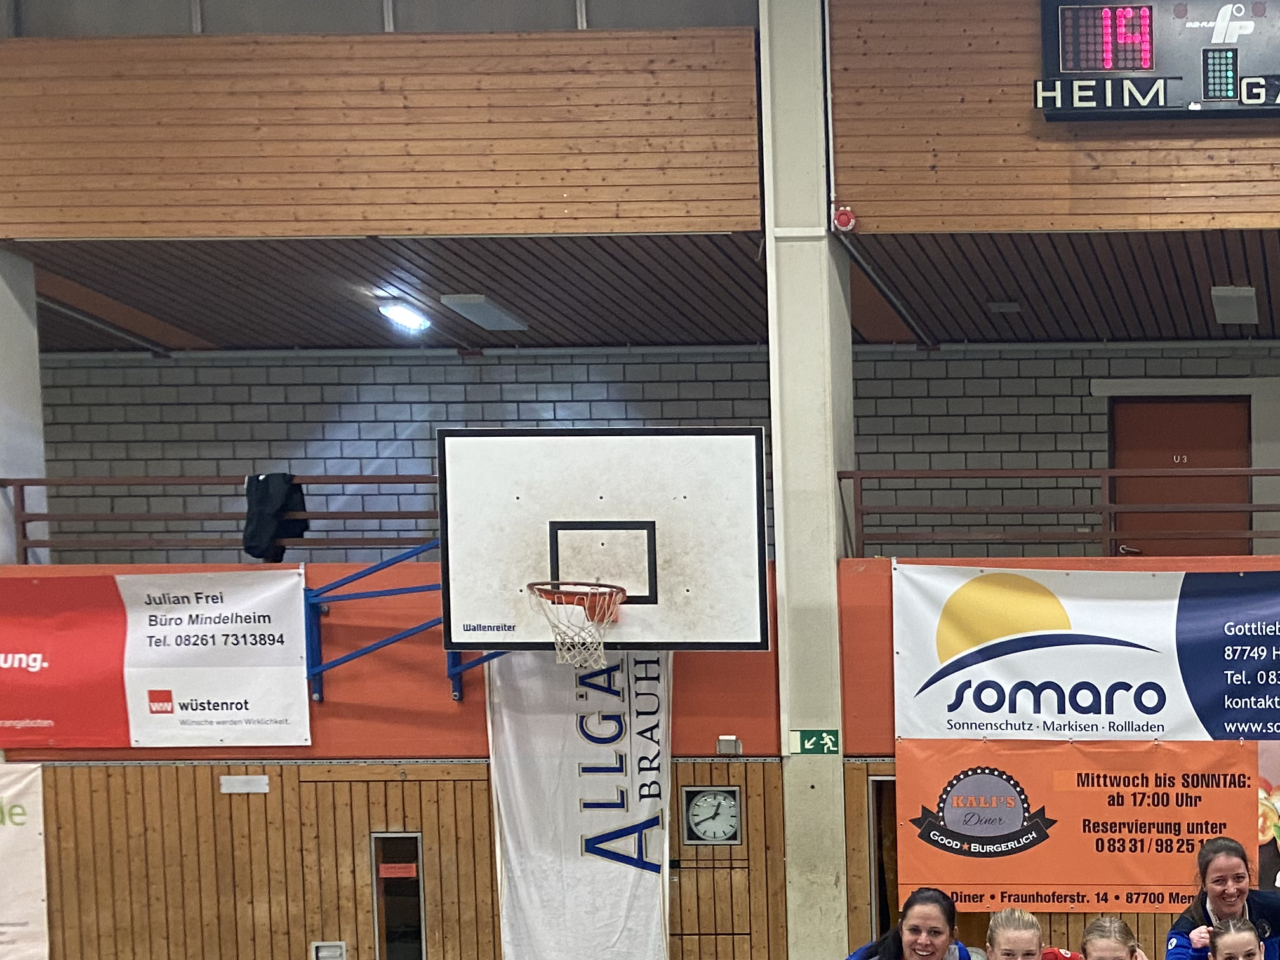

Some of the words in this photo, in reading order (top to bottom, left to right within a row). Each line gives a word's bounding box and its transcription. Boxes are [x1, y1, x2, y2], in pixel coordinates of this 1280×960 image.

[1037, 79, 1166, 108] HEIM
[144, 592, 191, 606] Julian
[195, 592, 224, 605] Frei
[148, 614, 183, 627] Büro
[187, 612, 272, 626] Mindelheim
[463, 623, 516, 632] Wallenreiter
[147, 635, 171, 647] Tel.
[175, 634, 216, 647] 08261
[222, 633, 285, 646] 7313894
[1224, 646, 1267, 660] 87749
[1224, 671, 1251, 684] Tel.
[947, 679, 1167, 715] somaro
[178, 698, 250, 711] wüstenrot
[947, 719, 1033, 732] Sonnenschutz
[1043, 720, 1098, 732] Markisen
[1108, 720, 1165, 733] Rollladen
[1076, 773, 1149, 788] Mittwoch
[1154, 773, 1175, 788] bis
[1182, 773, 1251, 789] SONNTAG:
[951, 796, 1016, 808] KALI'S
[1107, 792, 1124, 807] ab
[1131, 792, 1170, 807] 17:00
[1175, 793, 1202, 807] Uhr
[963, 811, 1006, 826] Diner
[1082, 819, 1181, 836] Reservierung
[1187, 820, 1227, 834] unter
[929, 830, 961, 849] GOOD
[951, 891, 985, 904] Diner
[1000, 892, 1091, 904] Fraunhoferstr.
[1095, 892, 1109, 904] 14
[1126, 892, 1164, 904] 87700
